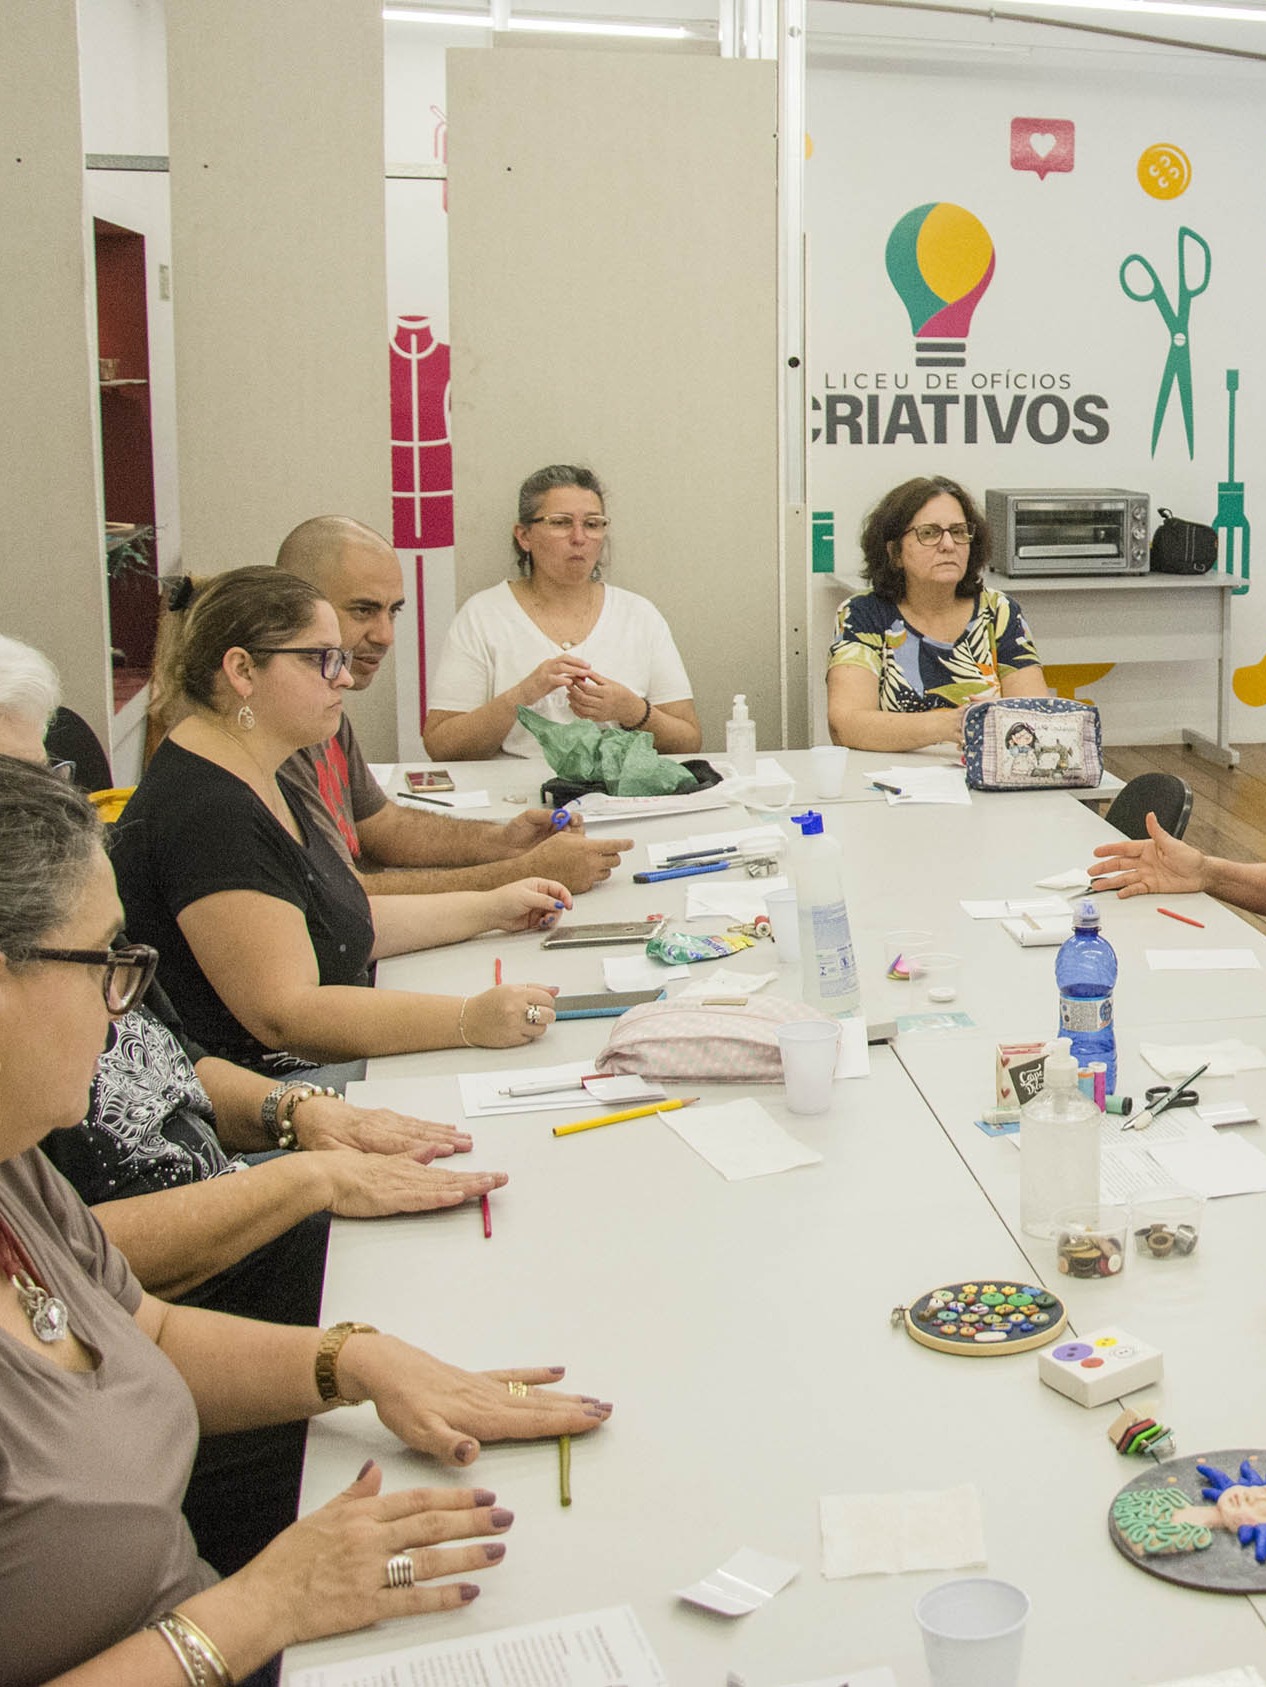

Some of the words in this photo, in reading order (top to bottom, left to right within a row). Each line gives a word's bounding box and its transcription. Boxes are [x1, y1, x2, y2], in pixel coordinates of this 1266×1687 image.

[825, 373, 908, 389] LICEU
[926, 373, 957, 389] DE
[972, 369, 1071, 389] OFÍCIOS
[812, 394, 1109, 445] RIATIVOS
